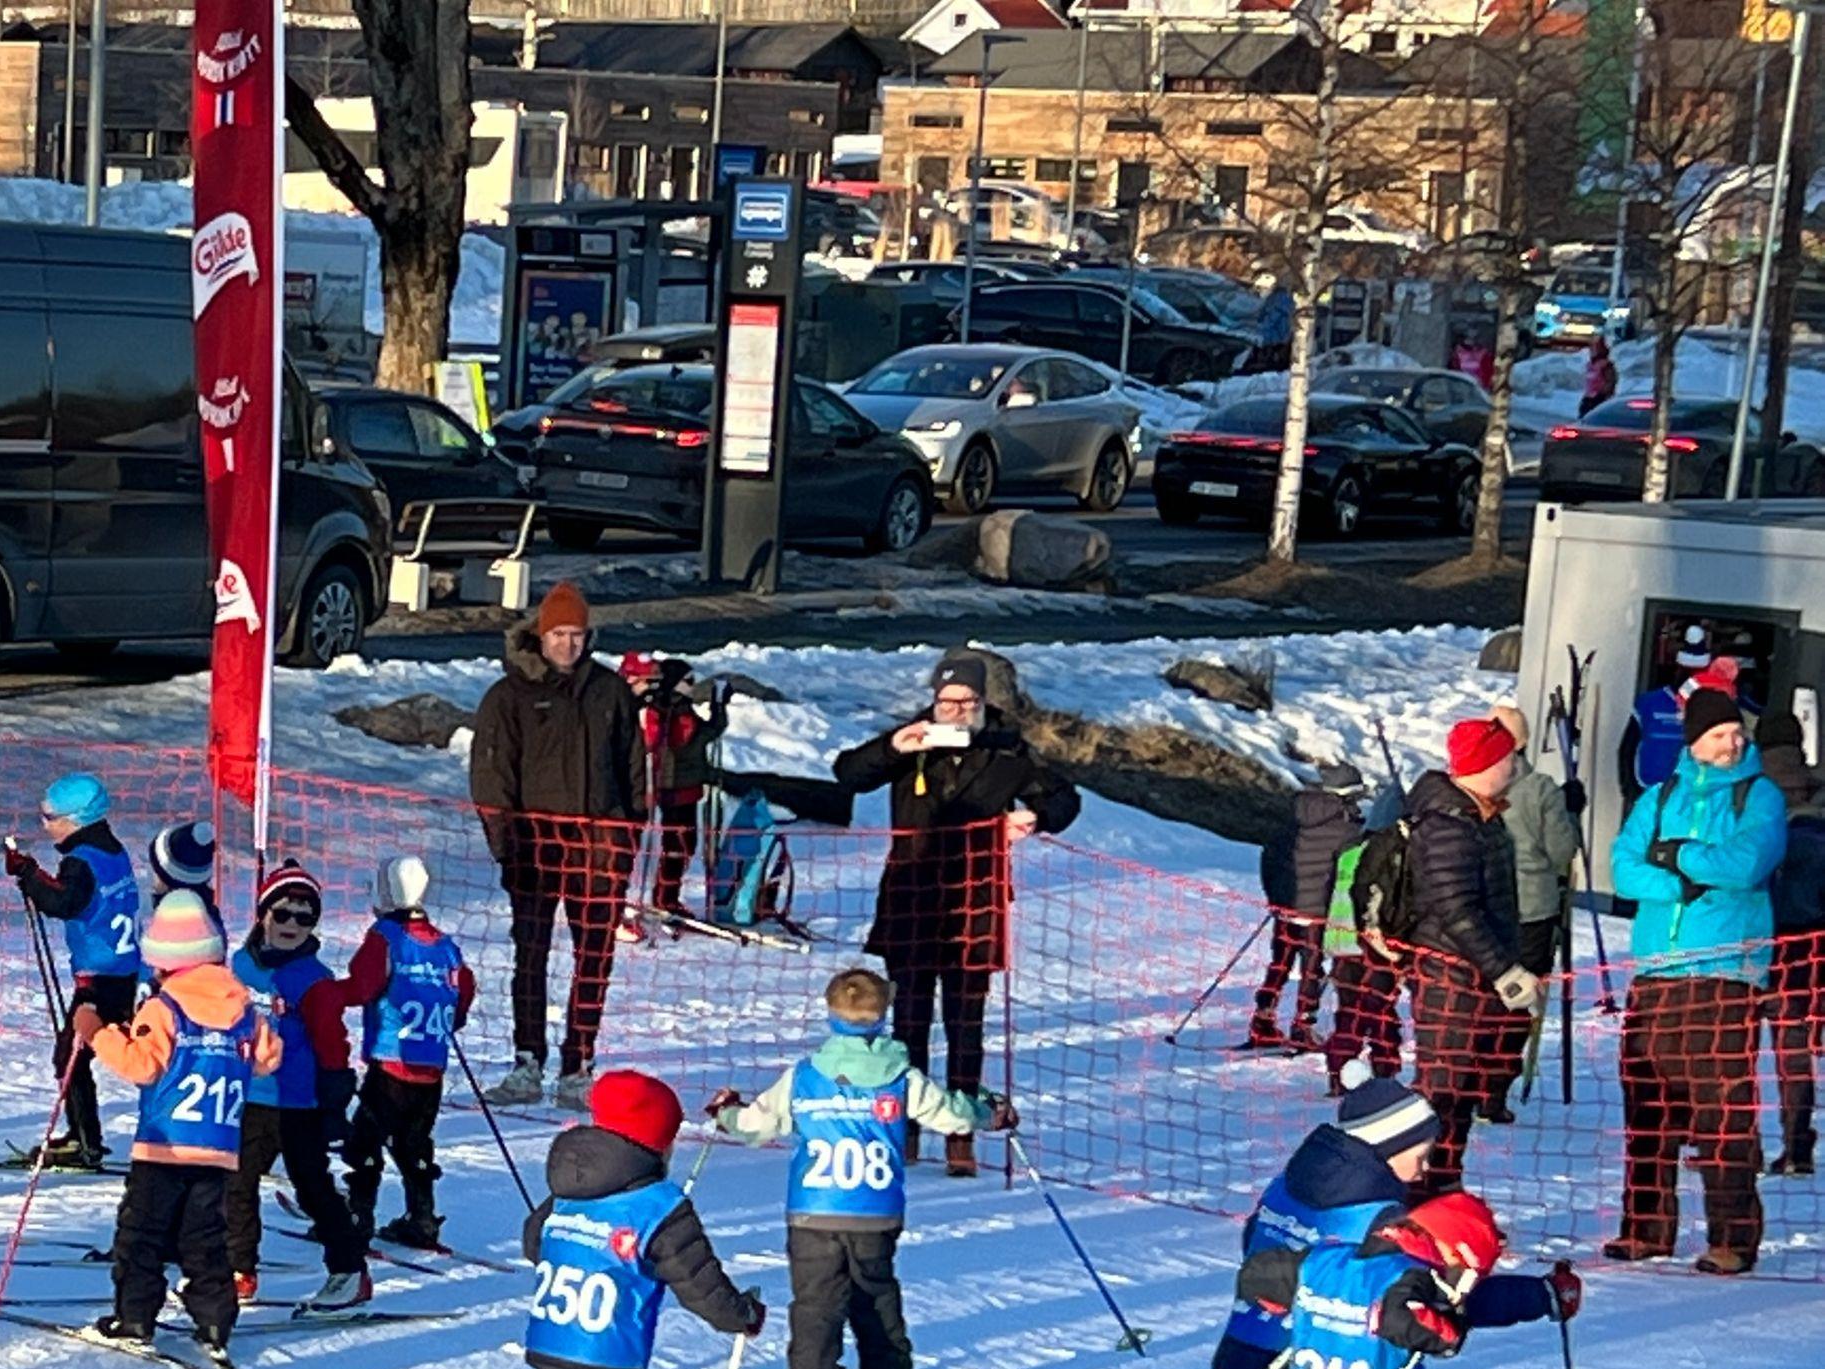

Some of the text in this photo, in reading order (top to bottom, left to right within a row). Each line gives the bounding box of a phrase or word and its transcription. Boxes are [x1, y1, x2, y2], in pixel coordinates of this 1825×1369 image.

[195, 222, 247, 276] Gilde
[171, 1073, 245, 1128] 212
[802, 1137, 894, 1190] 208
[531, 1260, 617, 1333] 250
